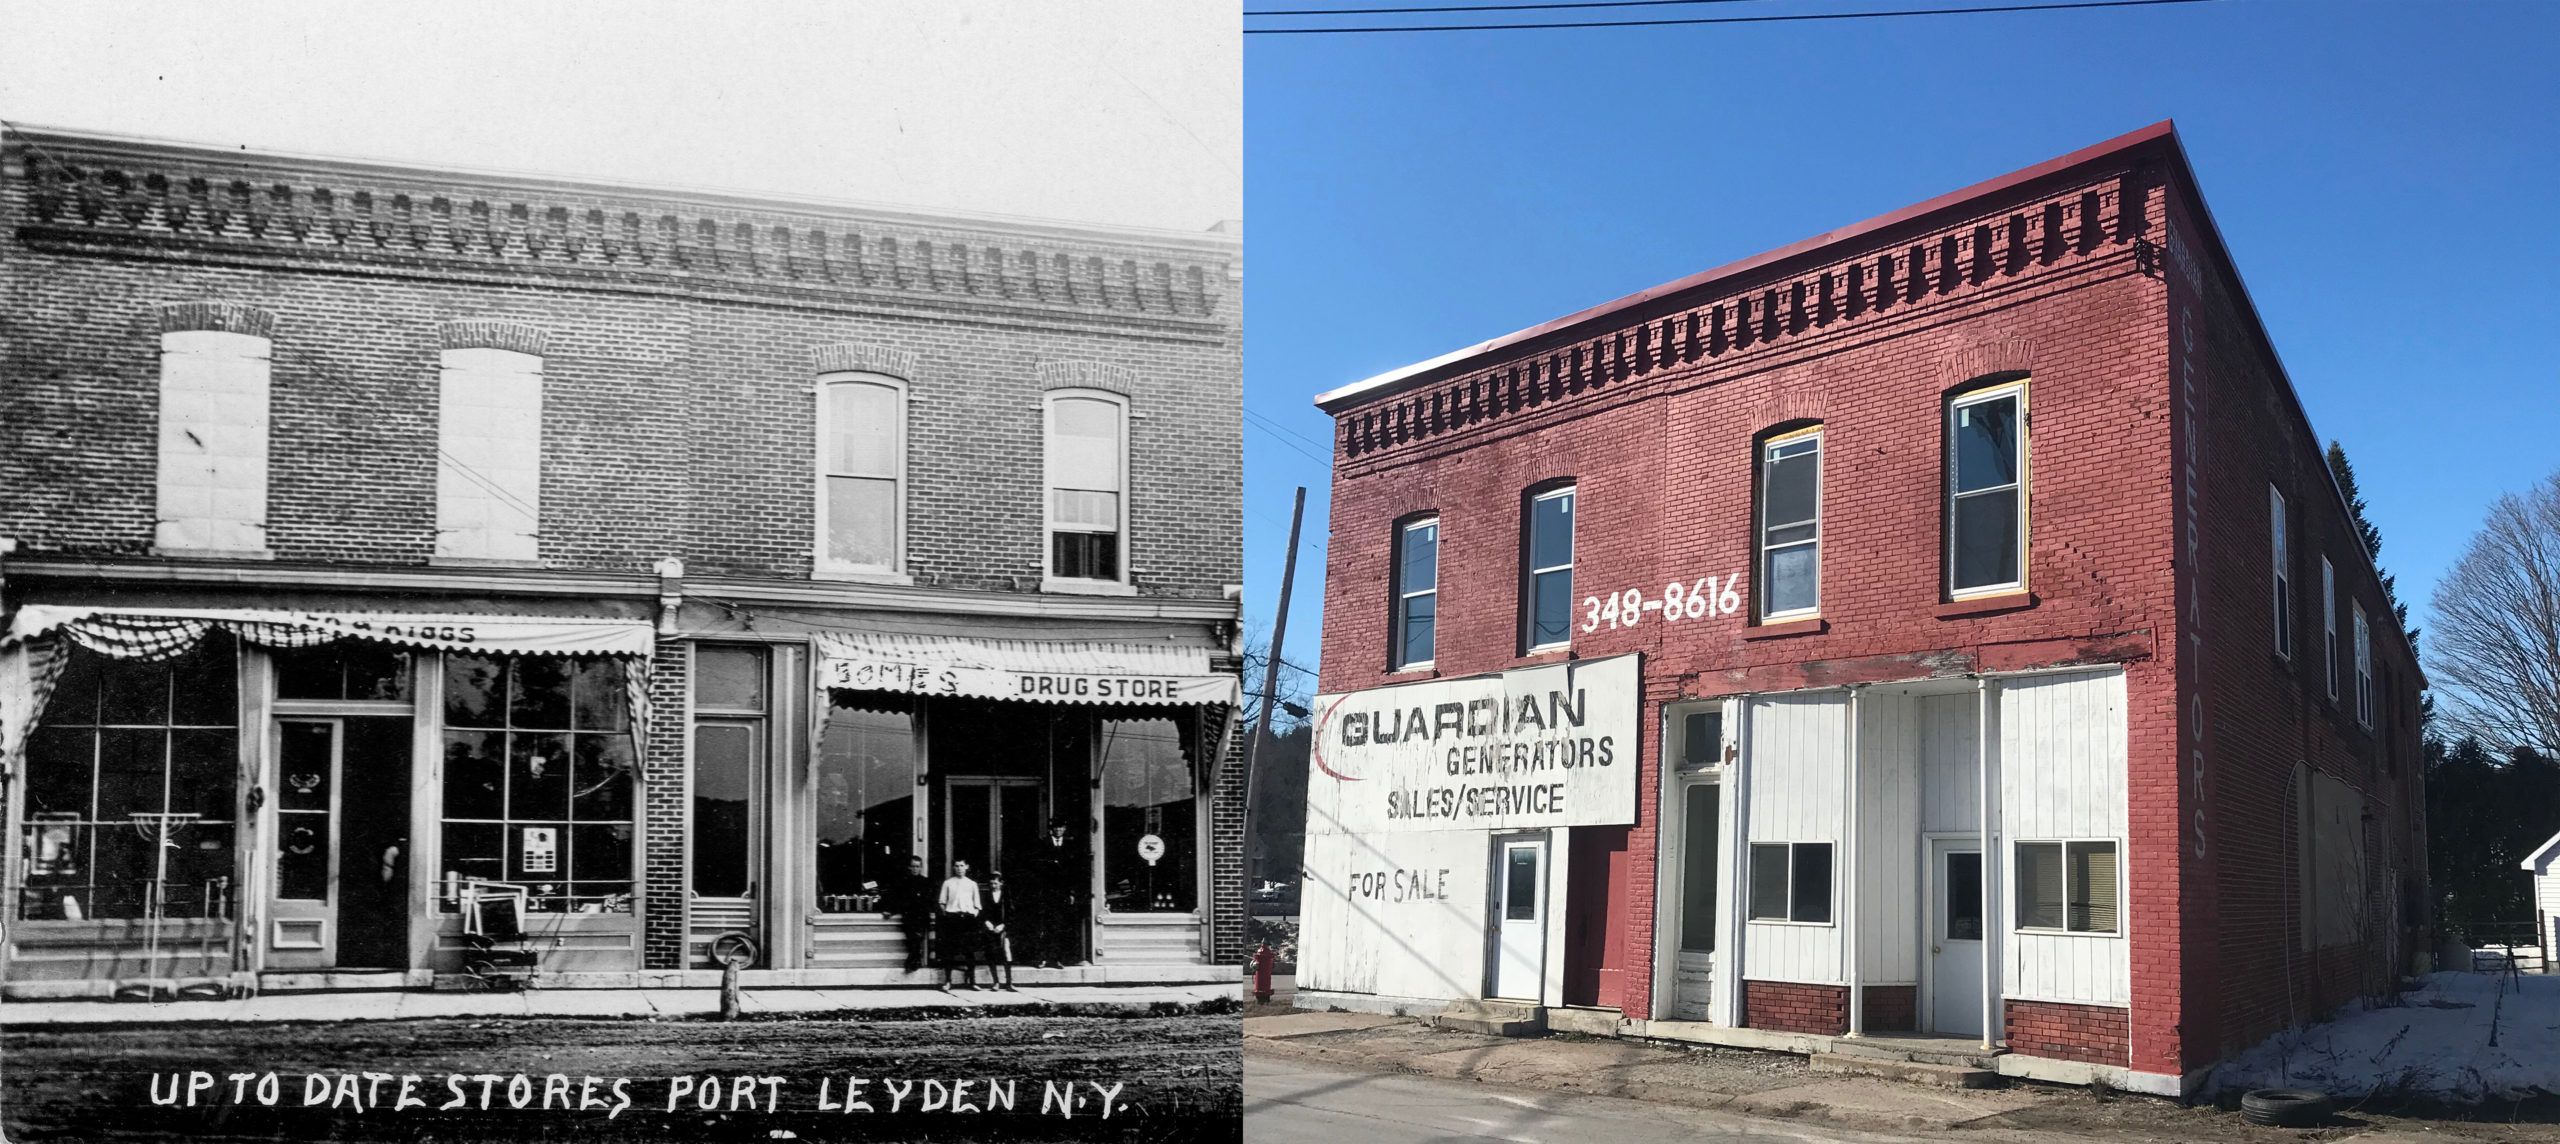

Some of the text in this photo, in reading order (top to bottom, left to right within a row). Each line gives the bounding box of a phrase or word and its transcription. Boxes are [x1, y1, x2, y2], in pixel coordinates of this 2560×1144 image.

[1582, 573, 1740, 634] 348-8616
[2182, 306, 2206, 859] GENERATORS
[1021, 675, 1088, 696] DRUG
[1097, 678, 1179, 698] STORE
[1342, 688, 1586, 747] GUARDIAN
[1446, 735, 1614, 777] GENERATORS
[1387, 783, 1564, 821] SALES/SERVICE
[1348, 868, 1450, 904] FOR SALE
